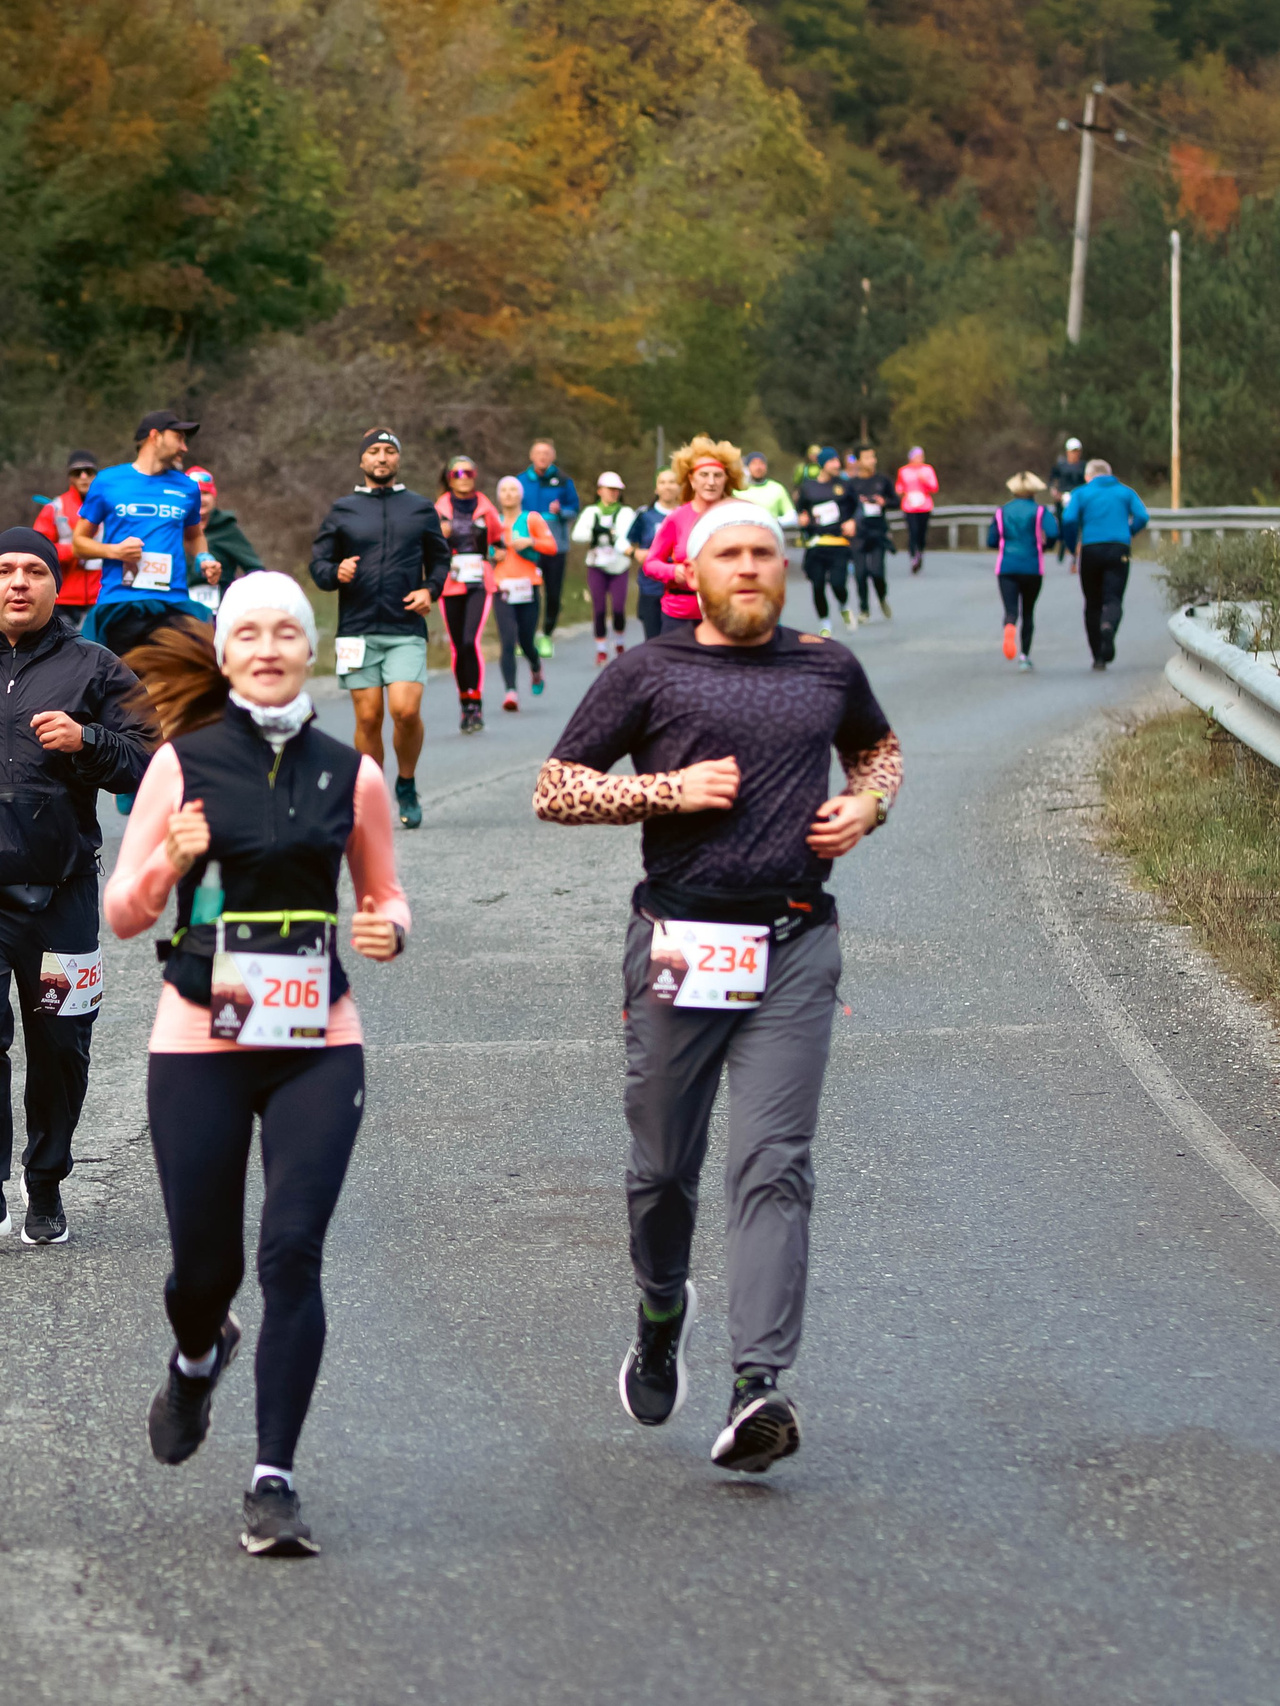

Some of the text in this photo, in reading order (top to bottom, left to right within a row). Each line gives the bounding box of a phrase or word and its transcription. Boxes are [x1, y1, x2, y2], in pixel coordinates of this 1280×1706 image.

[143, 561, 168, 575] 250
[698, 945, 757, 974] 234
[76, 961, 101, 990] 263
[263, 979, 320, 1009] 206
